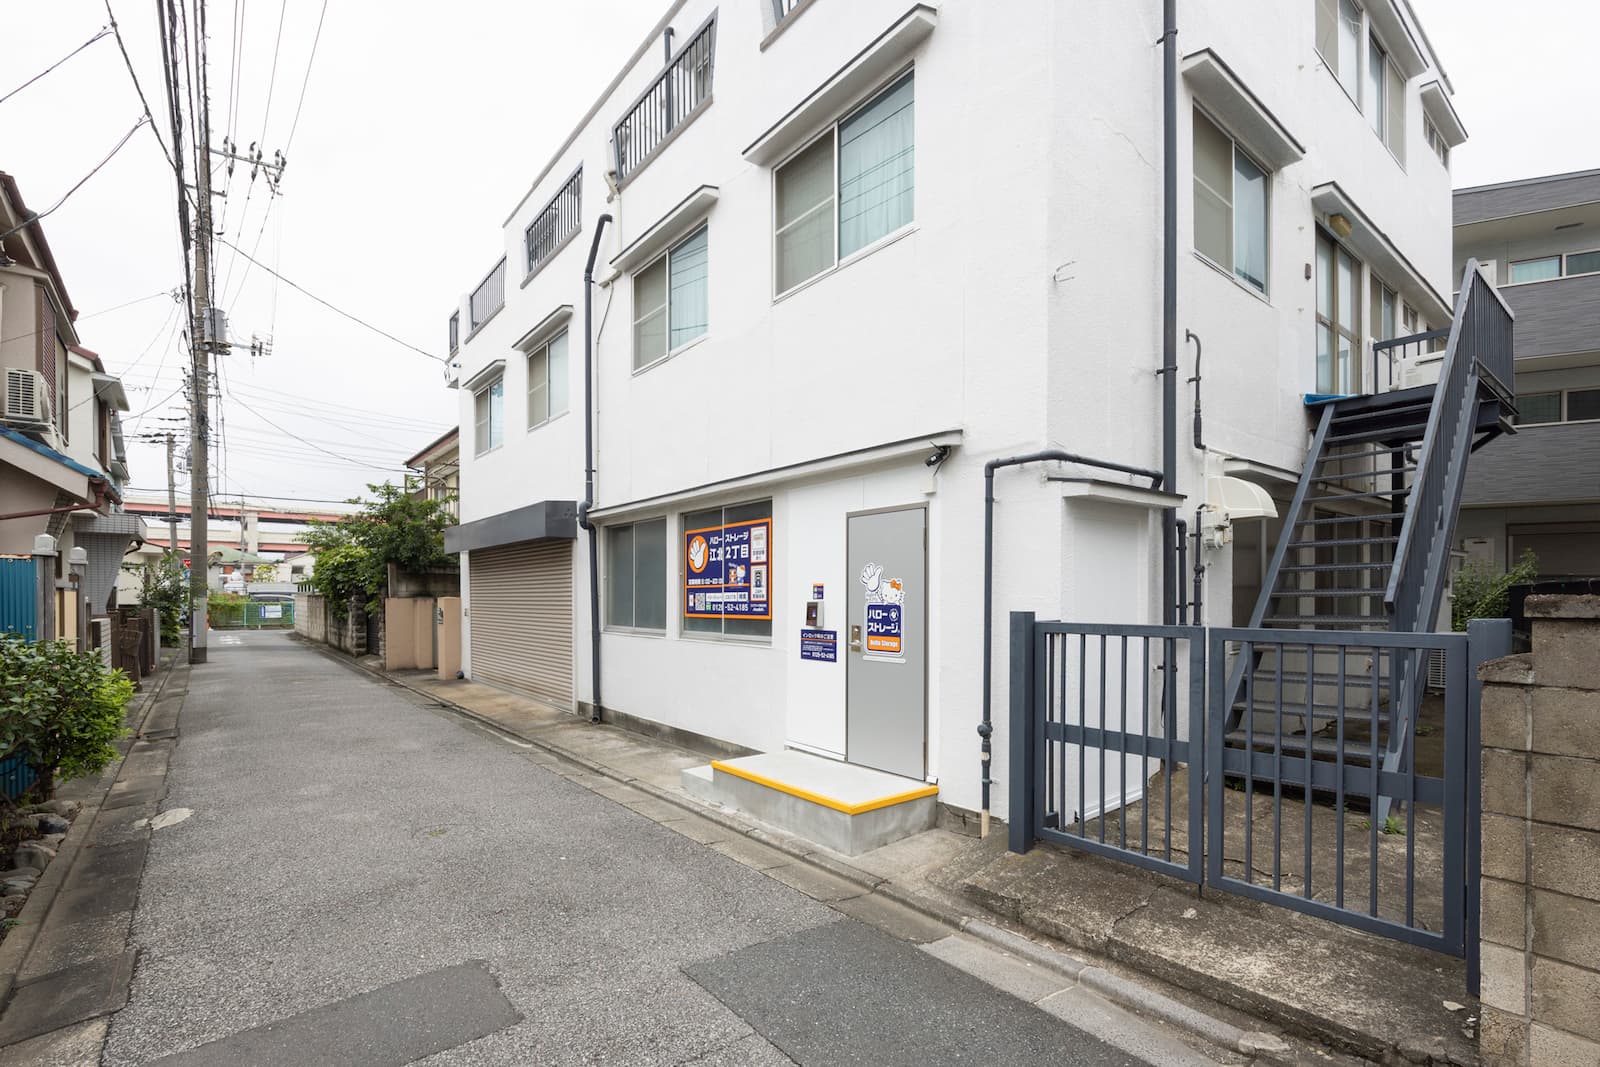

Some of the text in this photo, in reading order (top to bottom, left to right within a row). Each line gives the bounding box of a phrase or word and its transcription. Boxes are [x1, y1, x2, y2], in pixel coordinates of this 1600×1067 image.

[868, 609, 888, 619] ハロー
[868, 622, 899, 633] ストレージ
